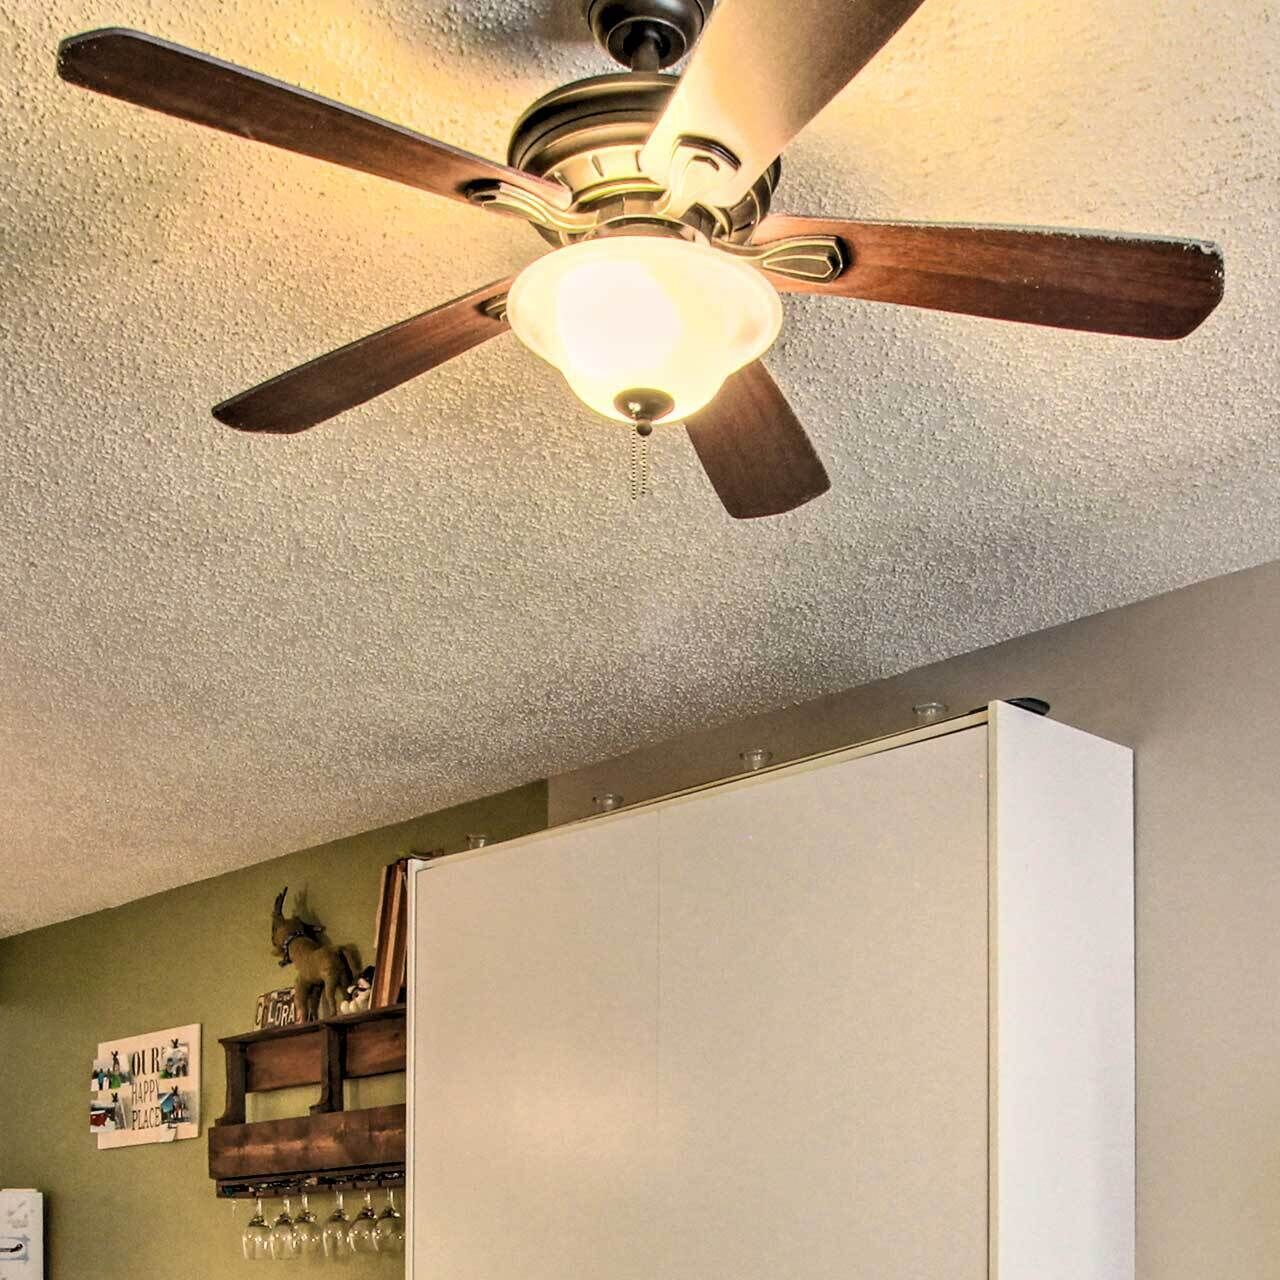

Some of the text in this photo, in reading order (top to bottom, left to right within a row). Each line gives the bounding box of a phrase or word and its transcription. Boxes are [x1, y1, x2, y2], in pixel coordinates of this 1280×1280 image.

[132, 1047, 160, 1076] OUR
[132, 1079, 160, 1105] HAPPY
[132, 1106, 160, 1131] PLACE
